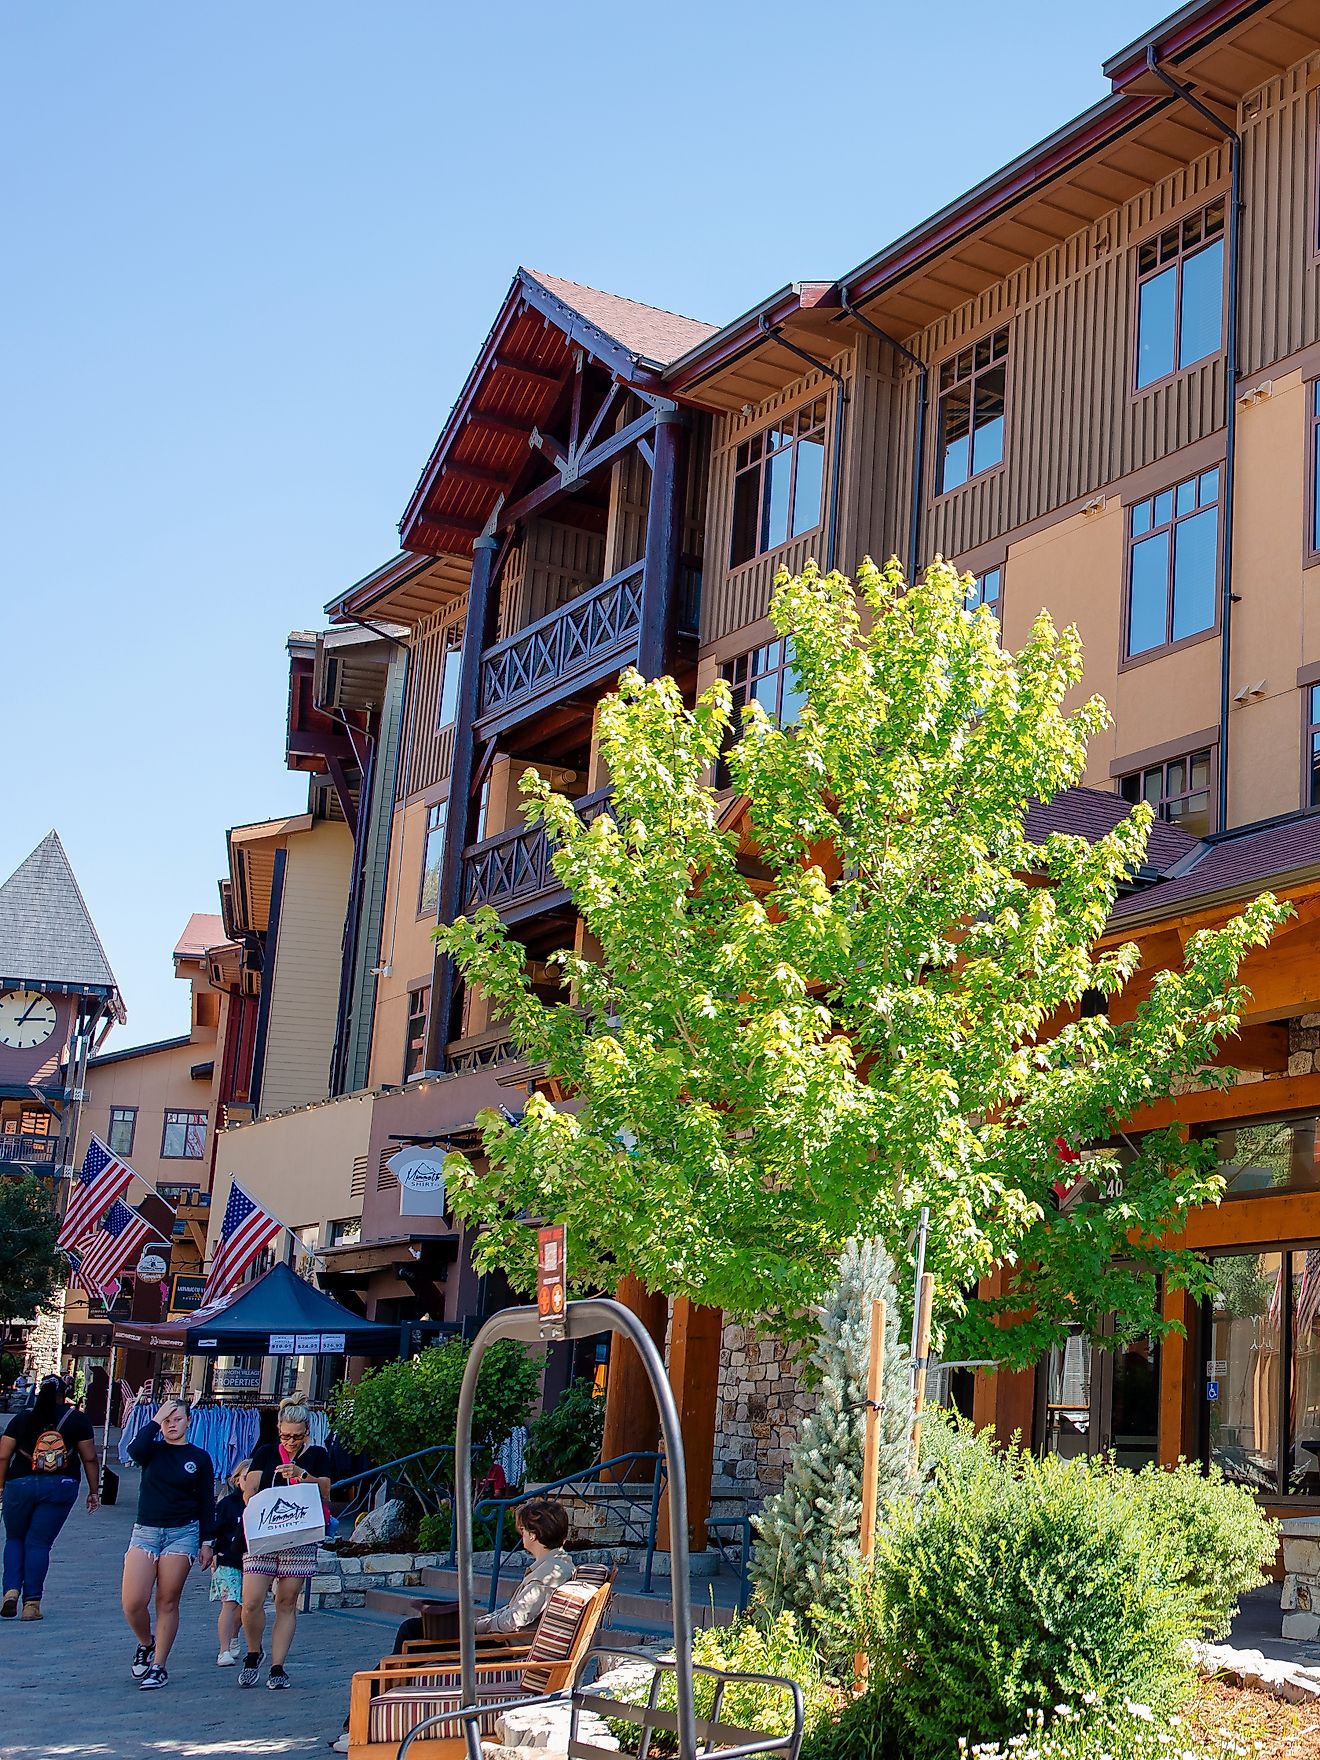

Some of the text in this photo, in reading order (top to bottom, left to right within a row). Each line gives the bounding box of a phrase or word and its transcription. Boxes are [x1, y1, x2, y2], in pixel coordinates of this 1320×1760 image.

[213, 1378, 260, 1387] PROPERTIES
[258, 1498, 309, 1530] Mammoth
[267, 1521, 300, 1530] SHIRT
